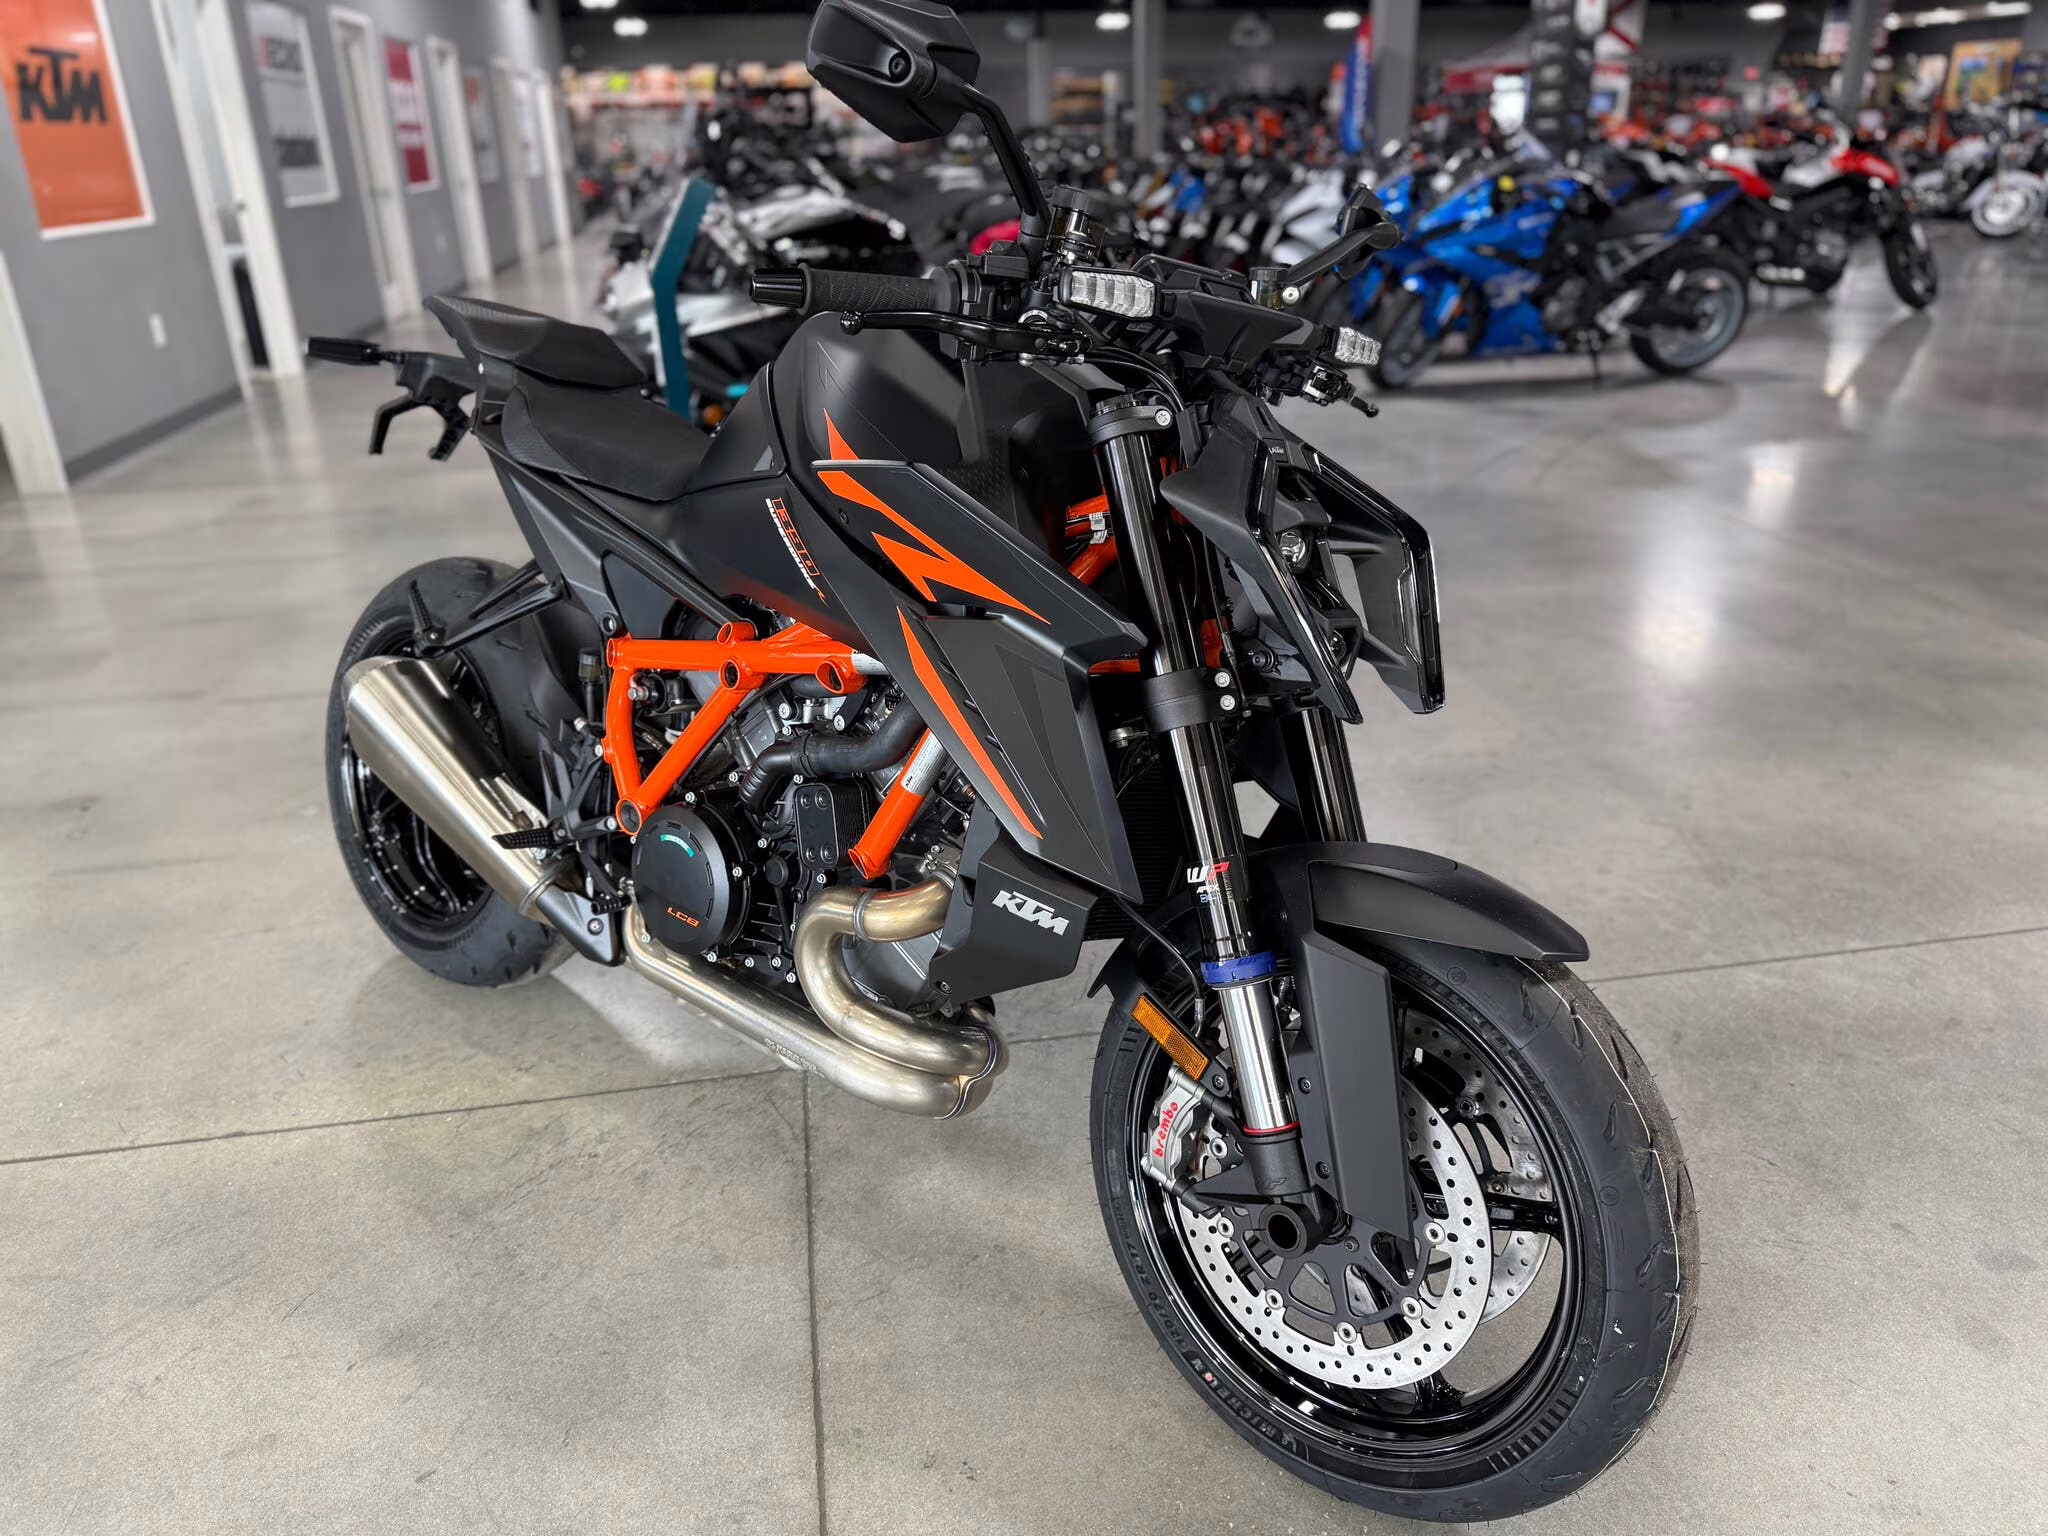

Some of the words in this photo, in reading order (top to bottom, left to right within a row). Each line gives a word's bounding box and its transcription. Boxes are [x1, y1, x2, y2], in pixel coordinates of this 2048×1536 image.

[16, 47, 108, 123] KTM
[1186, 861, 1231, 884] WP
[667, 906, 700, 928] LC8
[991, 889, 1070, 936] KTM
[1152, 1101, 1178, 1158] brembo
[1128, 1243, 1145, 1262] 17
[1134, 1264, 1151, 1286] ZR
[1147, 1292, 1186, 1350] 120/70
[1190, 1357, 1277, 1438] MICHELN
